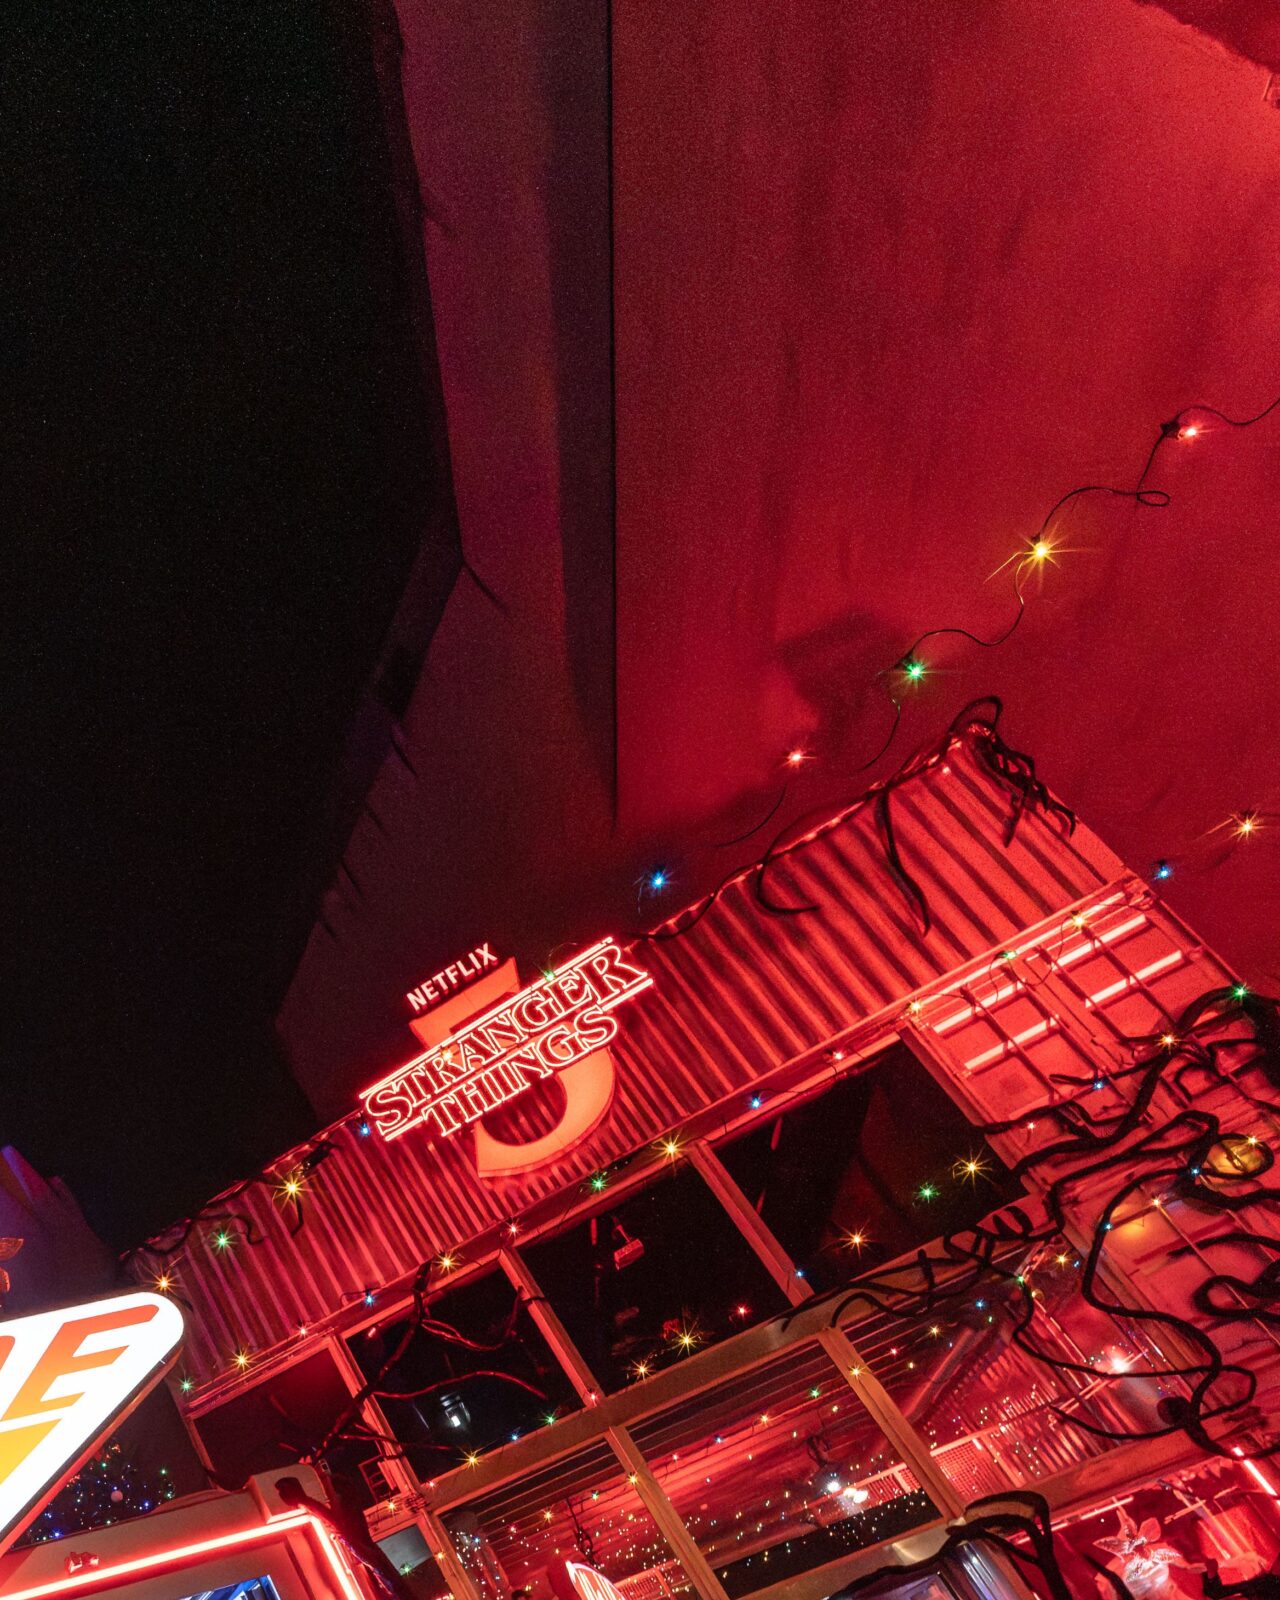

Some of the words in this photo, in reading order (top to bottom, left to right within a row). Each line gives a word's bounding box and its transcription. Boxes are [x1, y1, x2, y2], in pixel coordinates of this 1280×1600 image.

[365, 943, 649, 1137] STRANGER
[406, 943, 498, 1011] NETFLIX
[422, 1004, 618, 1137] THINGS
